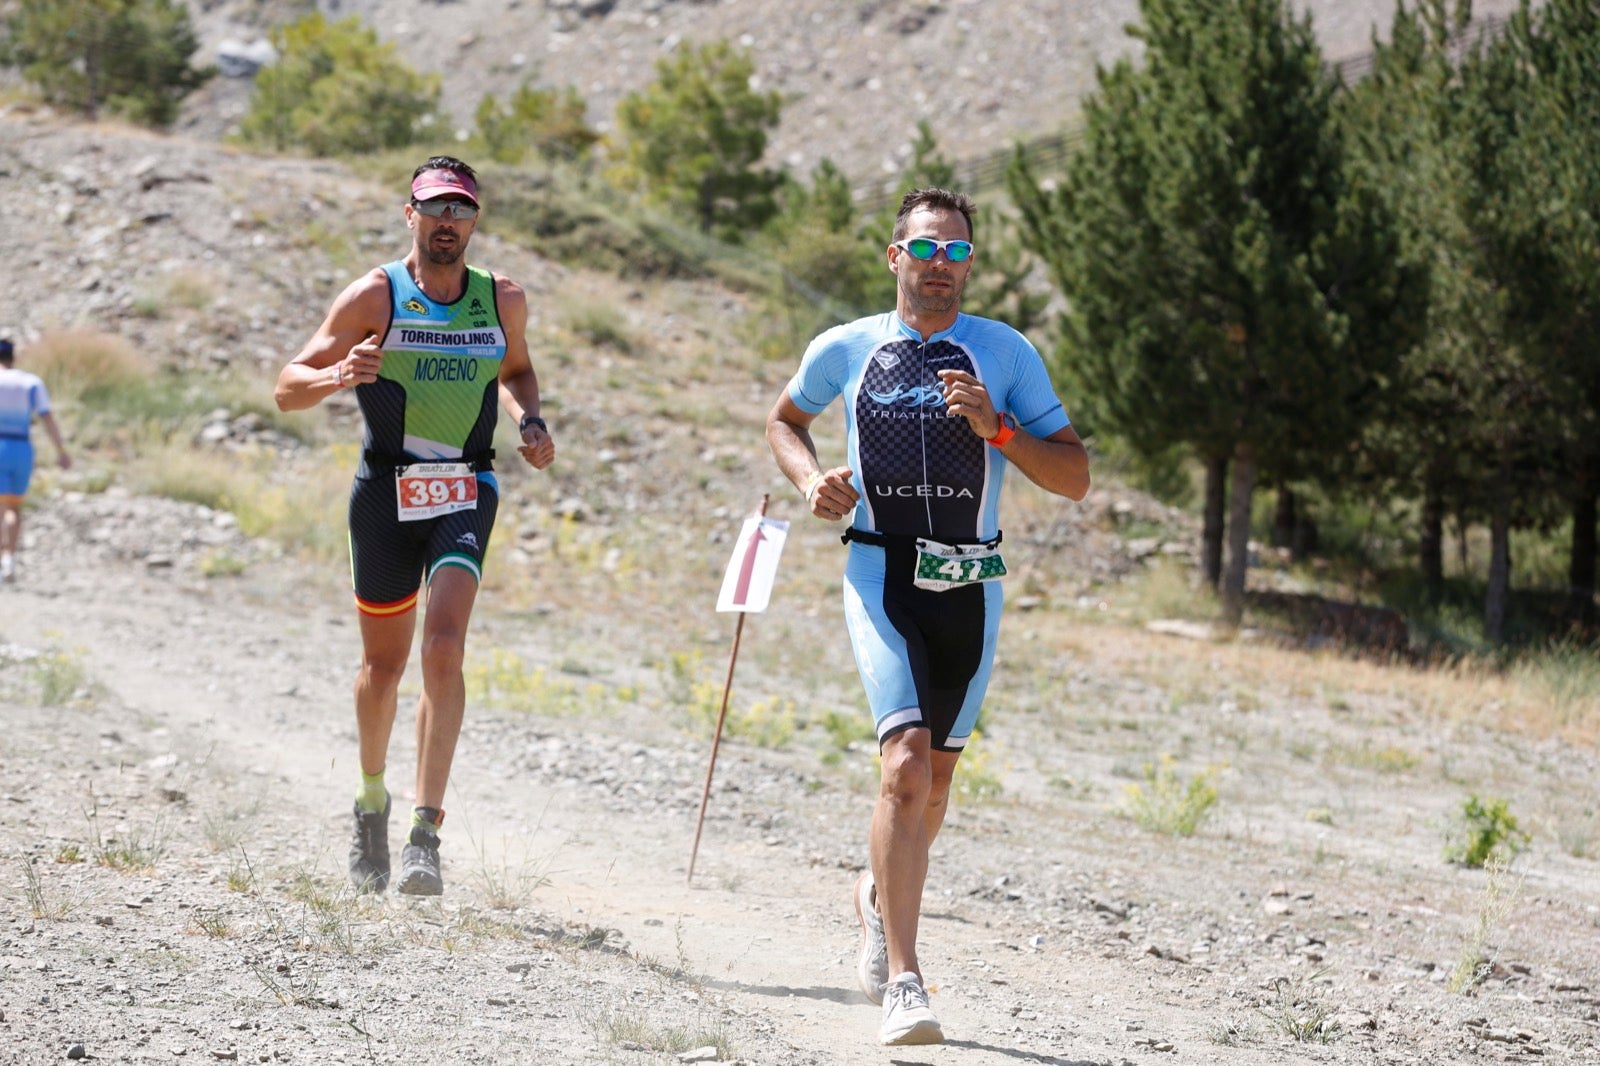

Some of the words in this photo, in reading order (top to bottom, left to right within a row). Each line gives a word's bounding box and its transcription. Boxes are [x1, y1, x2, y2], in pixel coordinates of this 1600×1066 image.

[400, 329, 496, 346] TORREMOLINOS
[414, 357, 478, 381] MORENO
[870, 409, 963, 420] TRIATHL
[408, 479, 466, 506] 391
[875, 484, 974, 499] UCEDA
[938, 559, 983, 580] 47
